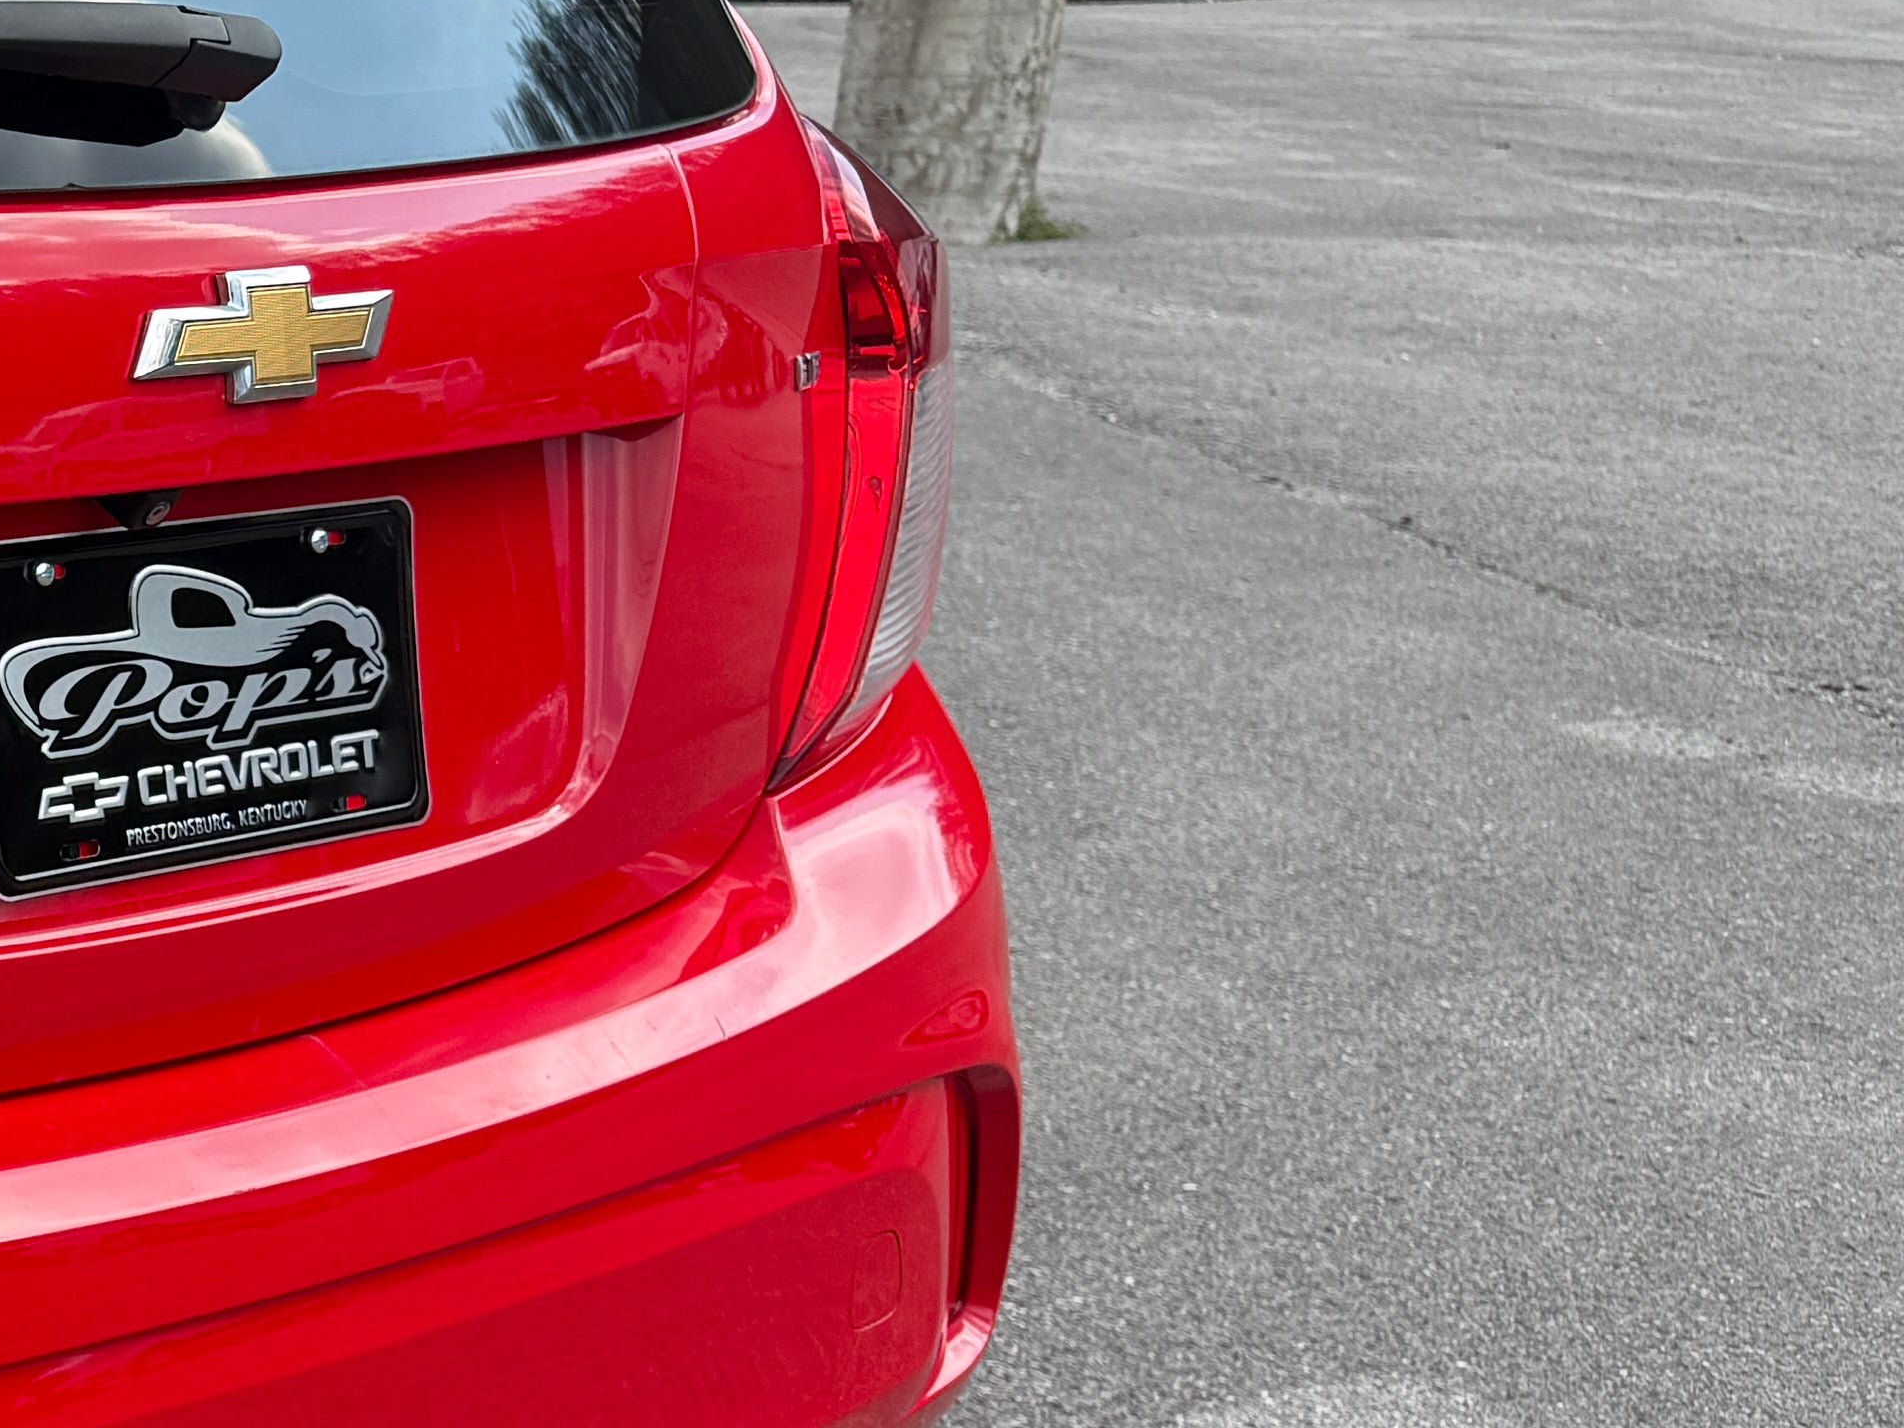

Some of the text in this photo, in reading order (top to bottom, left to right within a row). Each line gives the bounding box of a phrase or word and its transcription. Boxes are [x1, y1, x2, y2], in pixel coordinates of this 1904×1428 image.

[137, 729, 381, 806] CHEVROLET
[126, 798, 309, 847] PRESTONSBURG, KENTUCKY
